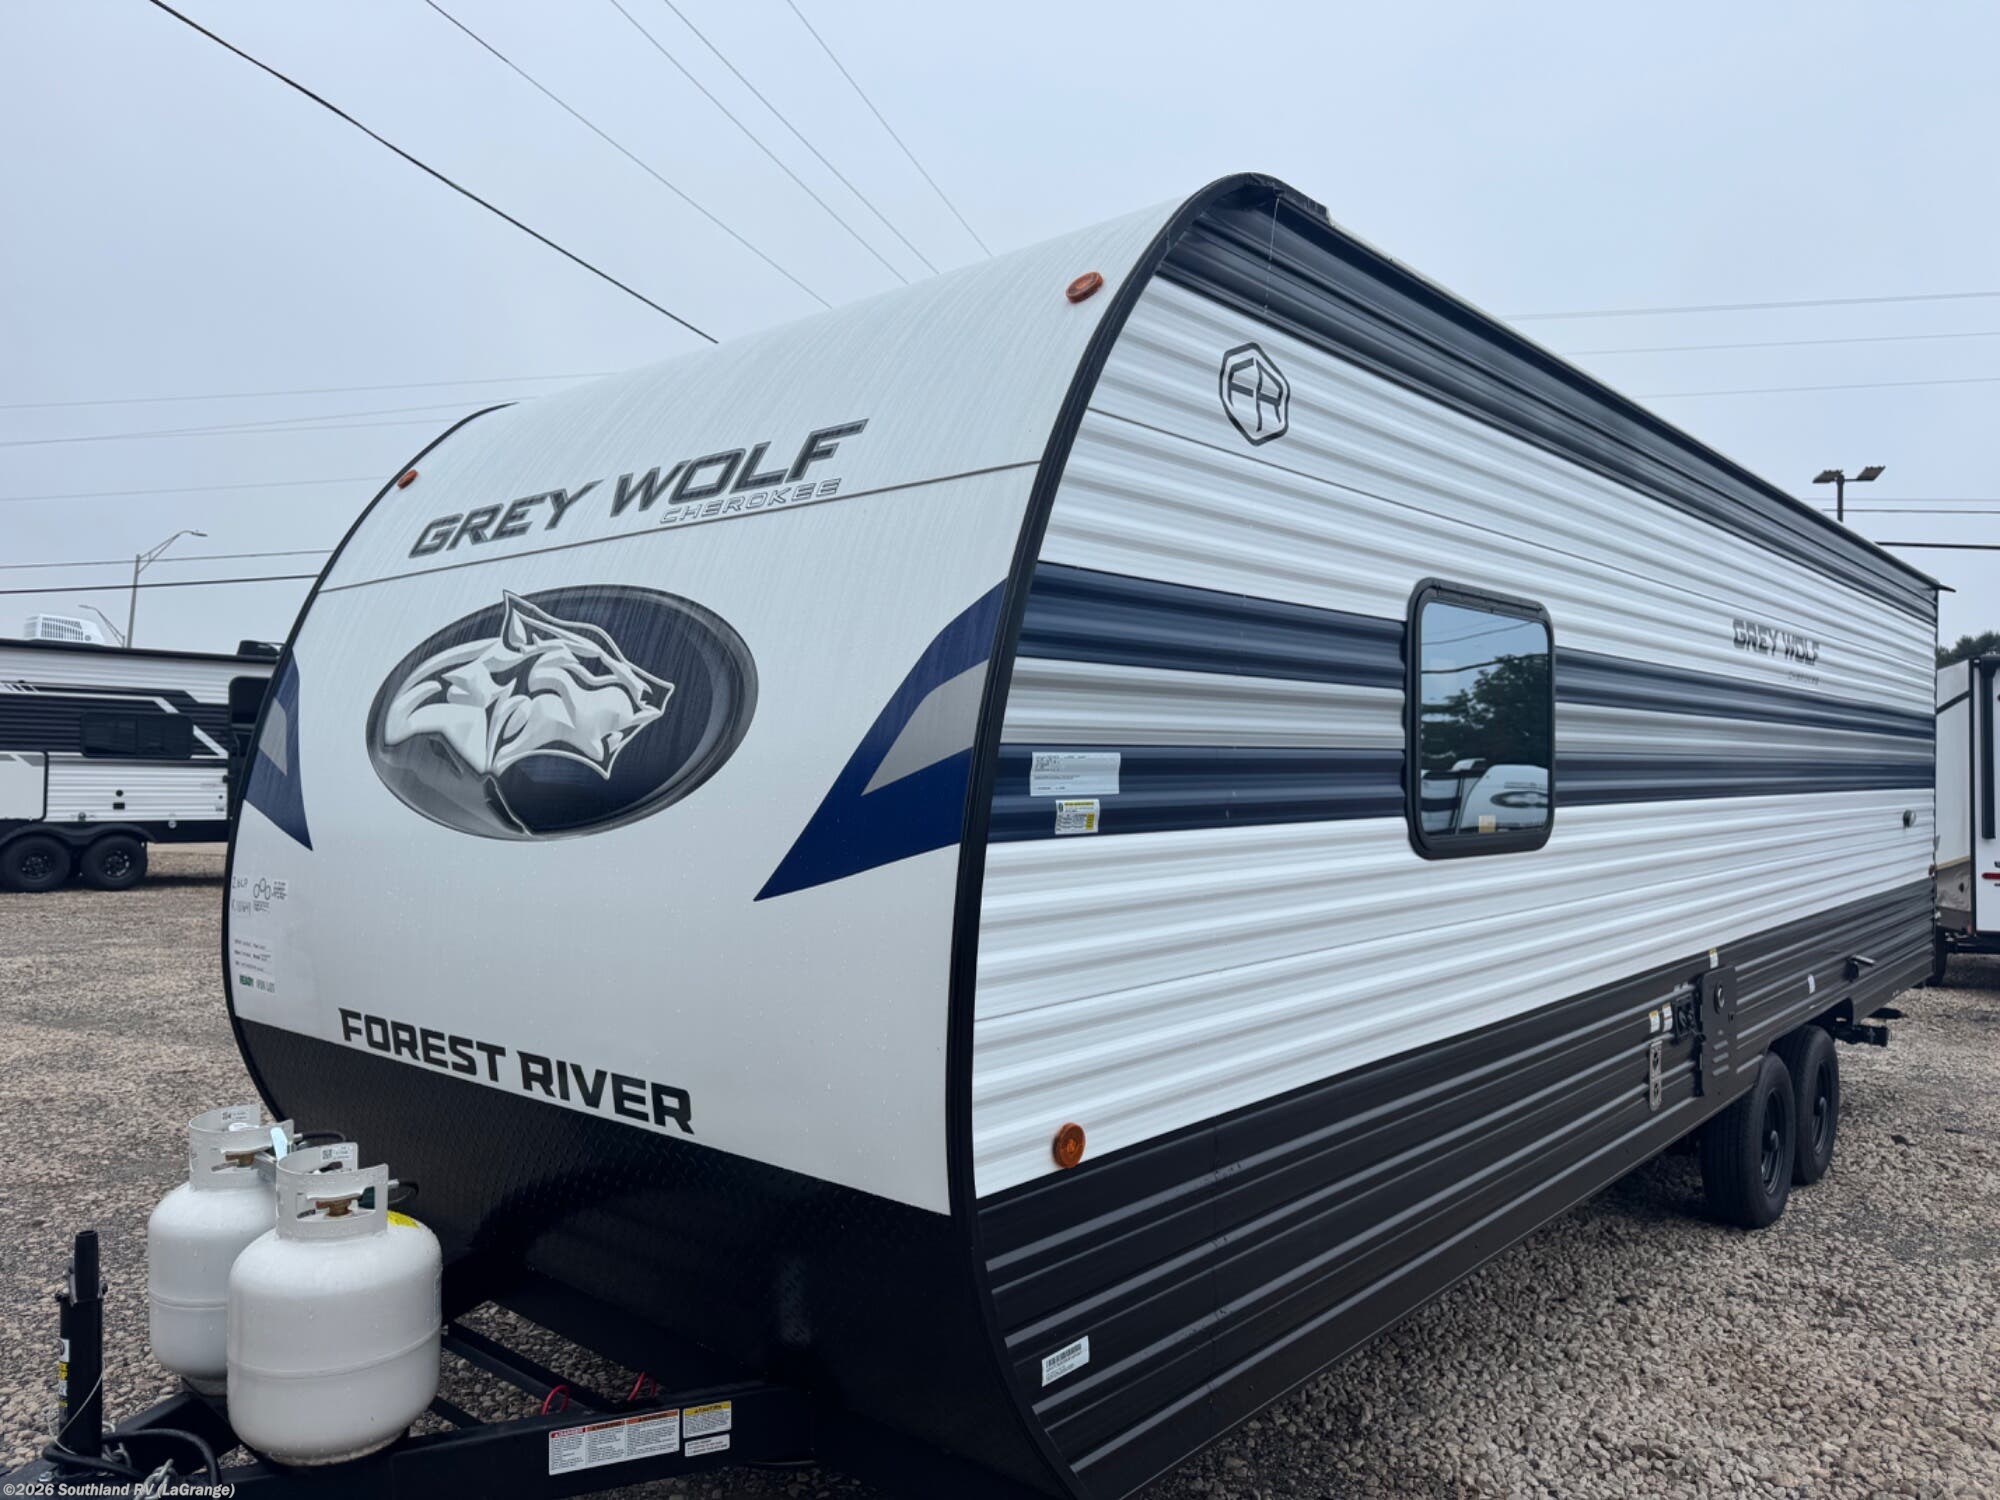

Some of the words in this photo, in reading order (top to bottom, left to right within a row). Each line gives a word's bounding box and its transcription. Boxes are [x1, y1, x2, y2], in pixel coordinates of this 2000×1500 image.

[408, 479, 604, 559] GREY
[610, 418, 870, 518] WOLF
[659, 477, 843, 525] CHEROKEE
[1732, 618, 1778, 657] GREY
[1783, 631, 1820, 667] WOLF
[338, 1007, 507, 1083] FOREST
[516, 1050, 695, 1136] RIVER
